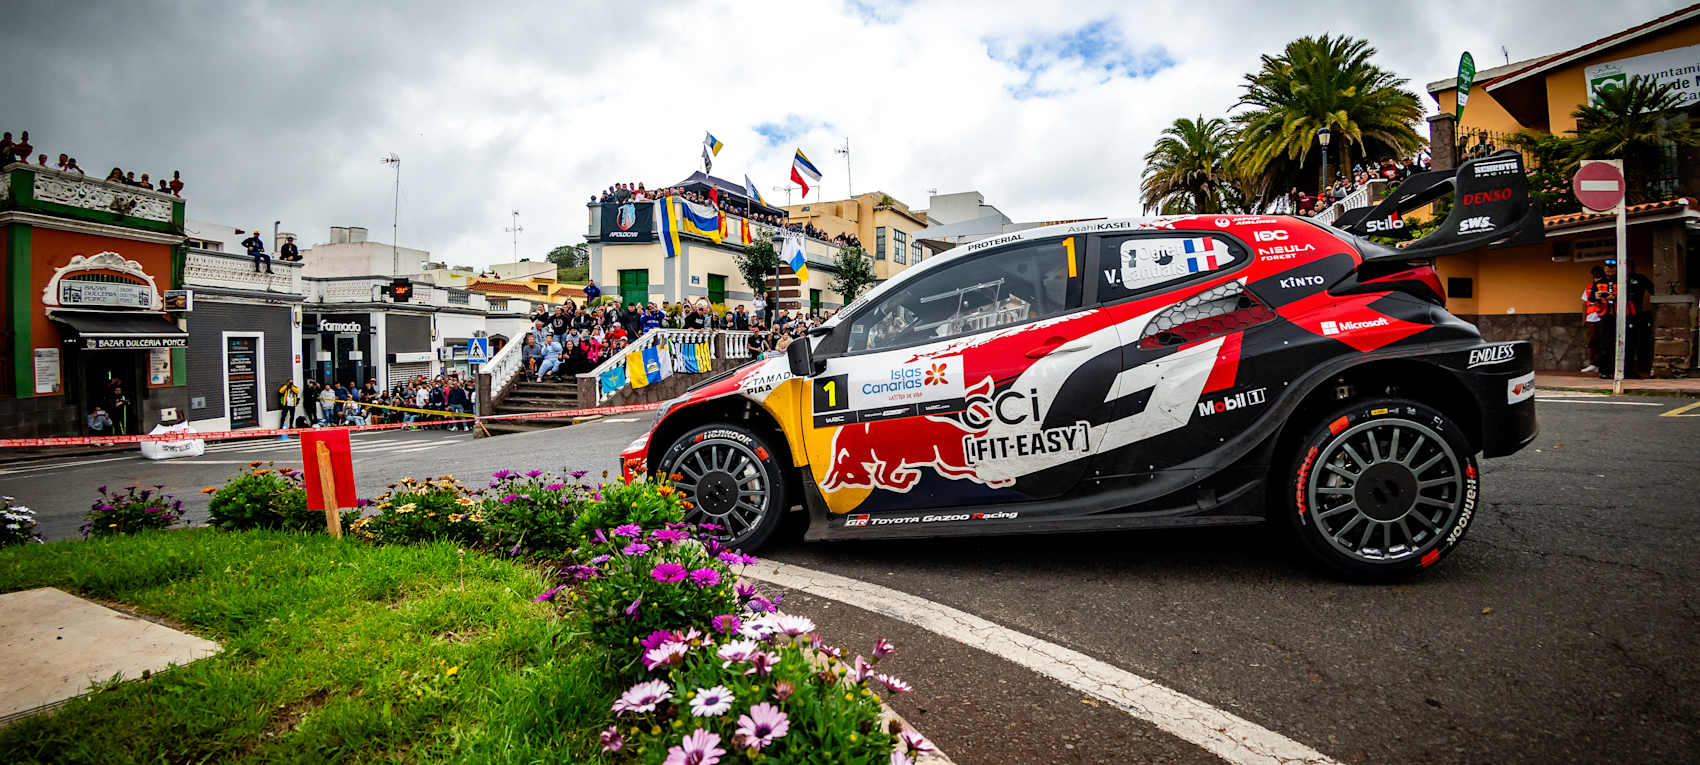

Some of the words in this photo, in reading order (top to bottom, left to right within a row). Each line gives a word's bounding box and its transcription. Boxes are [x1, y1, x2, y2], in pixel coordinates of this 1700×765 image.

[1673, 78, 1690, 90] de
[1463, 188, 1512, 206] DENSO
[1067, 221, 1131, 233] AsahiKASEI
[1459, 216, 1491, 232] SWS
[967, 234, 1024, 251] PROTERIAL
[1062, 237, 1078, 278] 1
[1261, 253, 1296, 261] FOREST
[1104, 269, 1120, 284] V.
[1339, 317, 1389, 331] Microsoft
[99, 339, 124, 347] BAZAR
[126, 339, 161, 347] DULCERIA
[1468, 344, 1515, 364] ENDLESS
[891, 367, 921, 381] Islas
[747, 384, 772, 395] PIAA
[823, 381, 837, 407] 1
[862, 378, 922, 395] Canarias
[1198, 393, 1246, 416] Mobil
[871, 517, 919, 525] TOYOTA
[922, 514, 970, 522] GAZOO
[972, 511, 1018, 521] Racing
